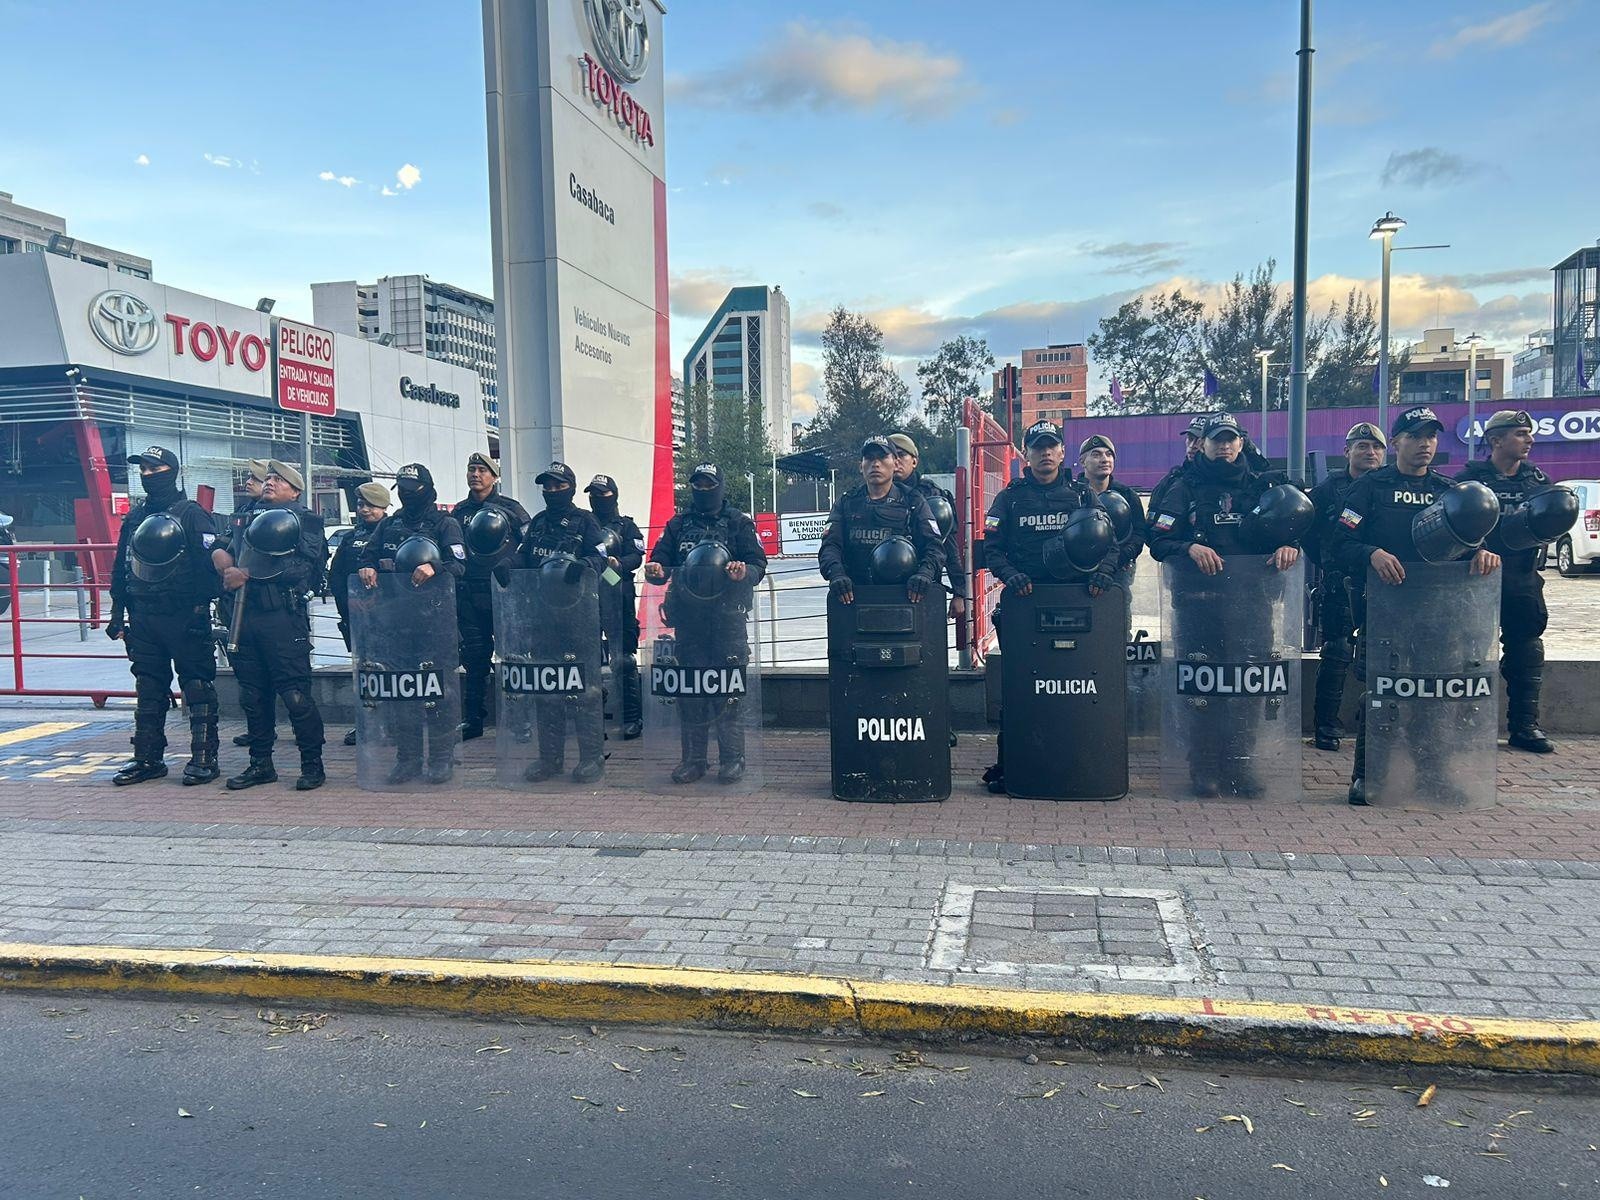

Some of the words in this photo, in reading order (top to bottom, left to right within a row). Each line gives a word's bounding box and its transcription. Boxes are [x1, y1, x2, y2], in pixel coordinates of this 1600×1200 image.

[584, 52, 654, 148] TOYOTA
[569, 172, 615, 226] Casabaca
[573, 305, 607, 337] Vehículos
[608, 322, 631, 347] Nuevos
[164, 313, 271, 371] TOYO
[281, 326, 332, 362] PELIGRO
[575, 334, 612, 365] Accesorios
[280, 364, 308, 383] ENTRADA
[313, 371, 334, 388] SALIDA
[287, 386, 296, 401] DE
[399, 375, 460, 409] Casabaca
[1394, 490, 1434, 505] POLIC
[359, 670, 443, 699] POLICIA
[501, 664, 584, 692] POLICIA
[651, 666, 746, 695] POLICIA
[1034, 678, 1098, 695] POLICIA
[1177, 664, 1288, 695] POLICIA
[1376, 676, 1492, 699] POLICIA
[857, 716, 926, 742] POLICIA
